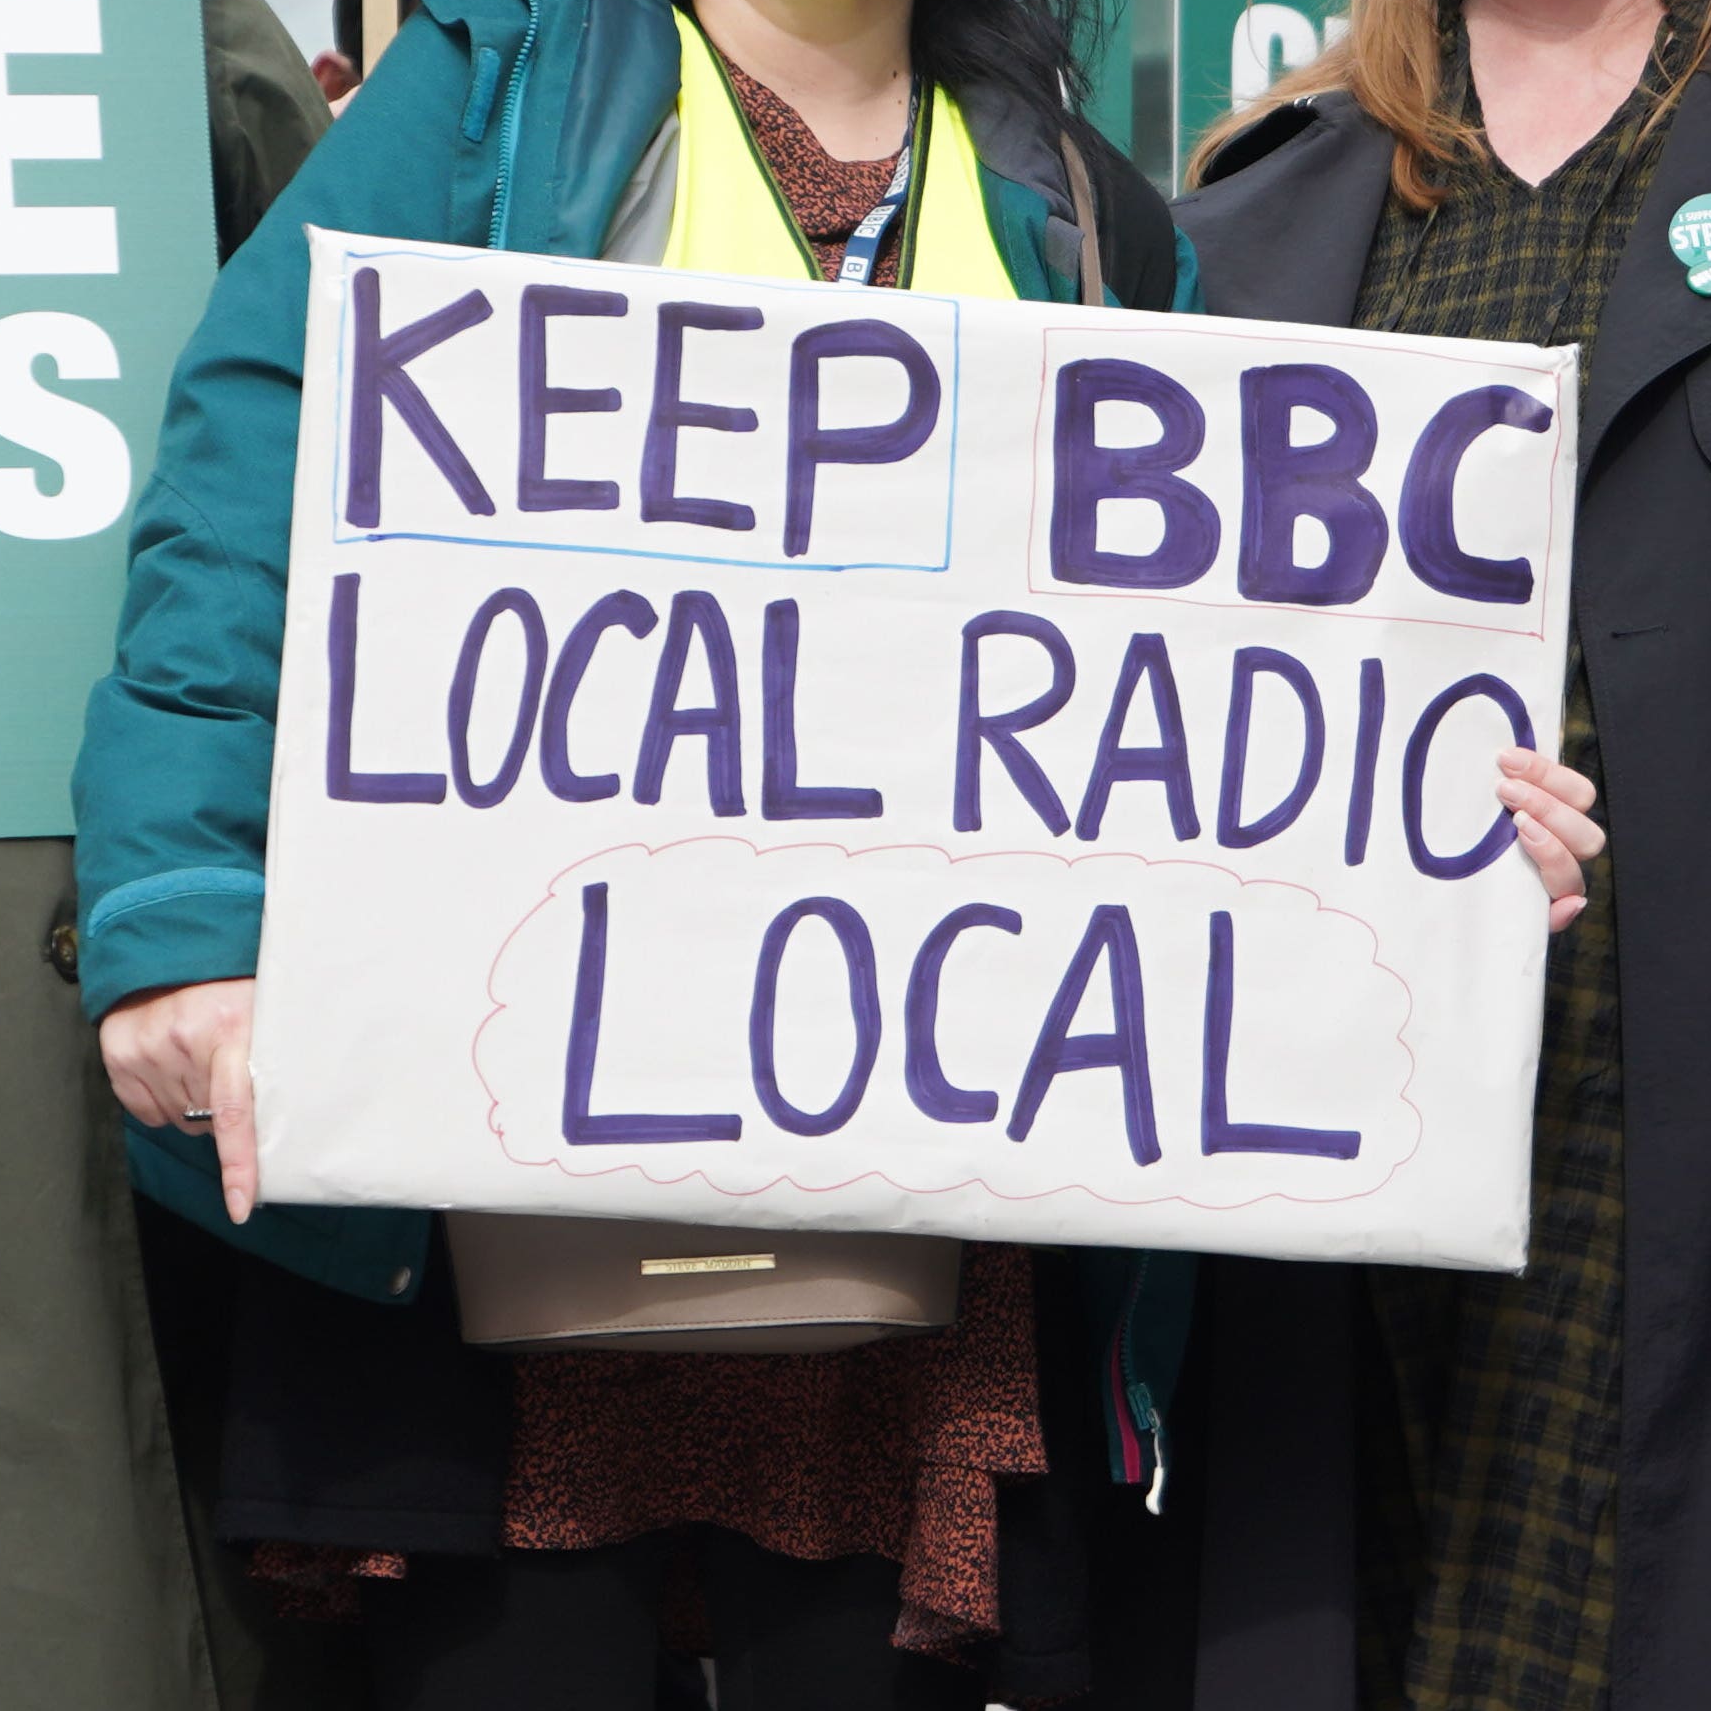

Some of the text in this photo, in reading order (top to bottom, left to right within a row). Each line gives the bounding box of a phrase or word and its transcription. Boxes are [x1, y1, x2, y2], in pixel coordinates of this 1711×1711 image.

[347, 268, 1554, 606] KEEP BBC
[328, 573, 1537, 881] LOCAL RADIO
[563, 882, 1361, 1167] LOCAL
